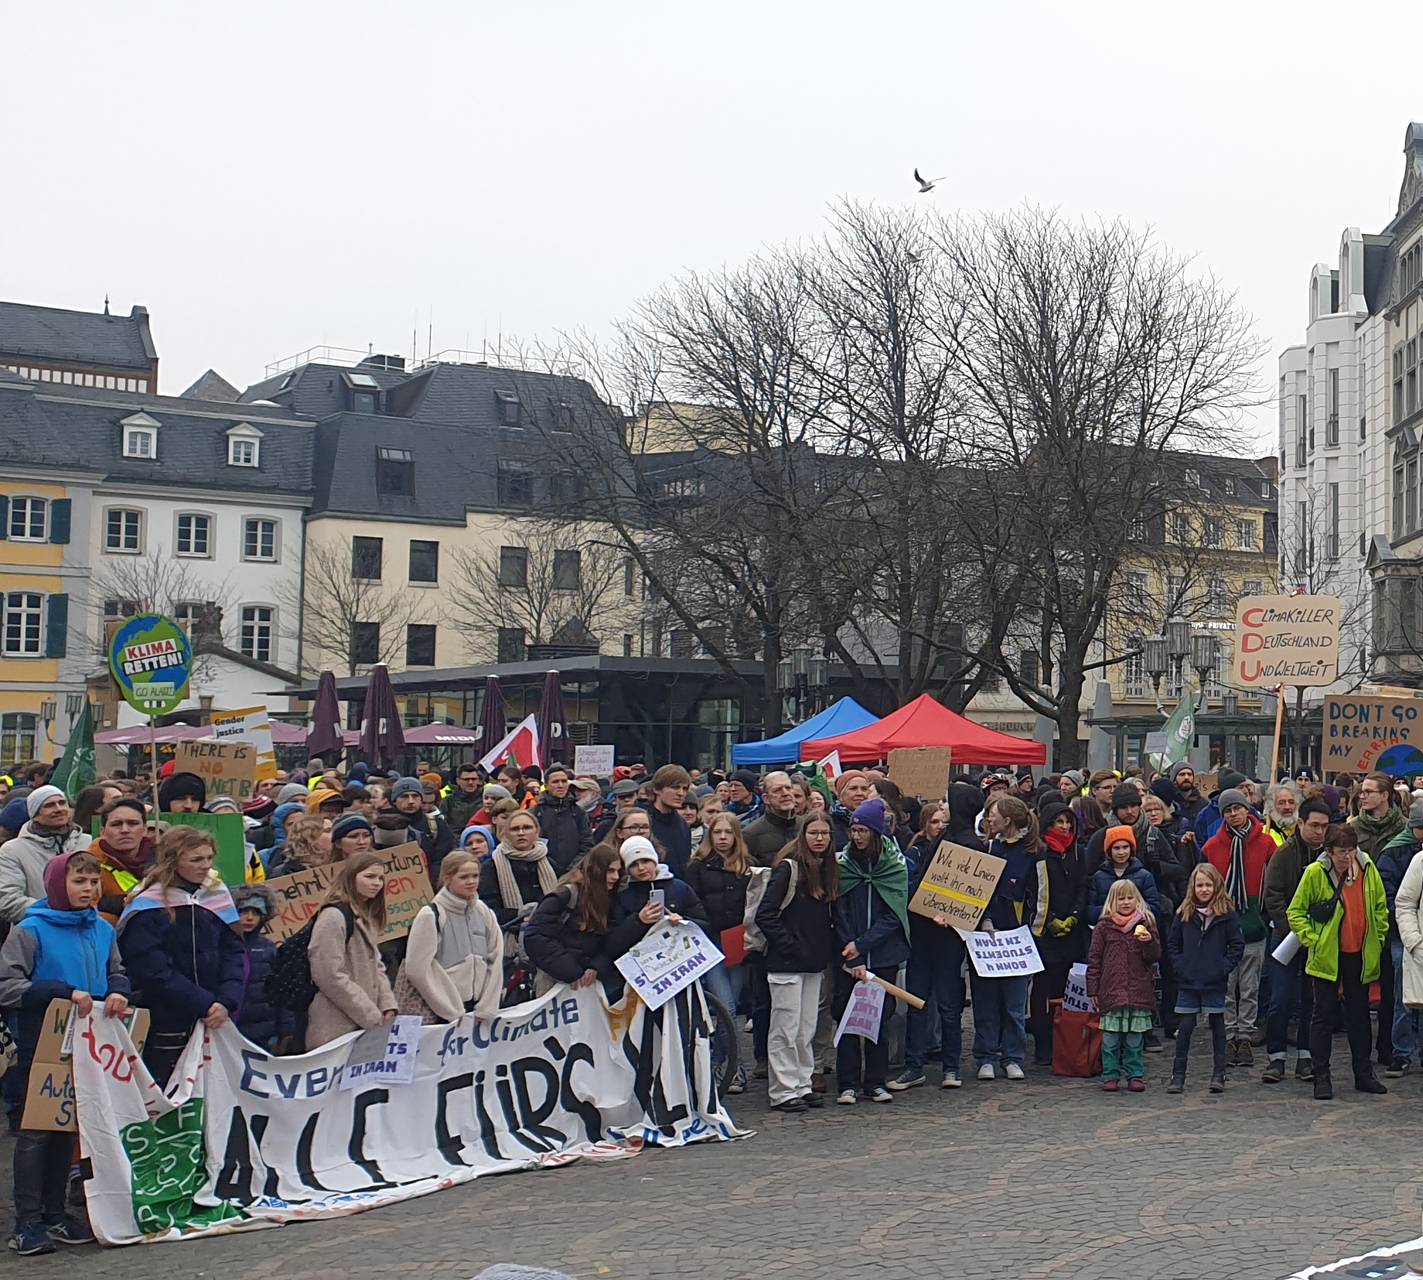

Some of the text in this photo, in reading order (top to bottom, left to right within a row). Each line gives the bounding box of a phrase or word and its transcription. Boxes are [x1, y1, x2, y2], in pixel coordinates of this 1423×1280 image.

[127, 640, 175, 660] KLIMA
[1241, 633, 1333, 653] DEUTSCHLAND
[124, 652, 184, 675] RETTEN!
[214, 716, 245, 726] Gender
[1329, 702, 1418, 723] DON'T GO
[216, 727, 244, 739] justice
[1329, 724, 1410, 740] BREAKING
[181, 741, 227, 758] THERE
[1329, 744, 1353, 757] MY
[201, 761, 224, 775] NO
[936, 848, 953, 868] Wie
[975, 935, 1021, 948] IN IRAN
[975, 945, 1033, 959] STUDENTS
[997, 960, 1027, 969] BONN
[652, 976, 673, 995] IN
[672, 952, 707, 982] IRAN
[472, 998, 579, 1049] Climate
[214, 1089, 438, 1206] ALLE
